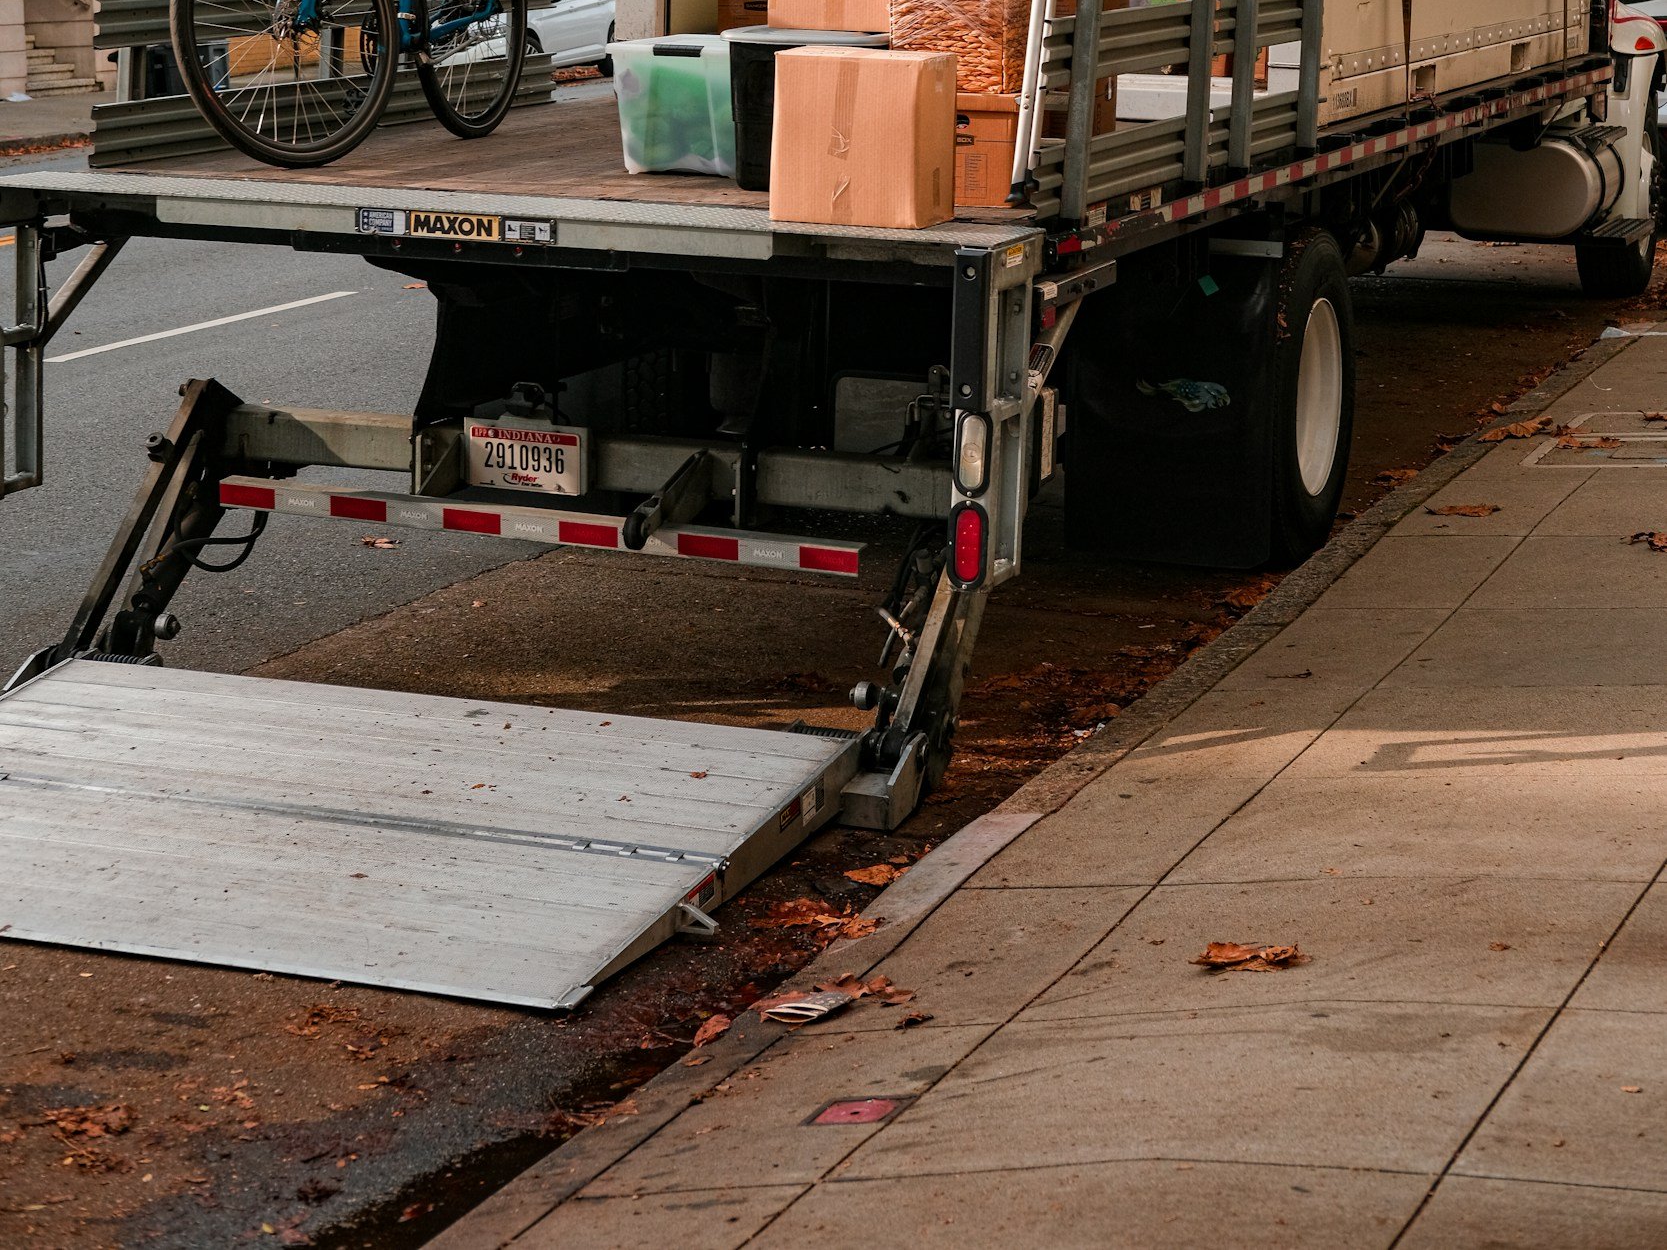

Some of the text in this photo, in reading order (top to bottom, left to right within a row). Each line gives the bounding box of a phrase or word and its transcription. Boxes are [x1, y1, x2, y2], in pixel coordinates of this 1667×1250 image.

[369, 211, 393, 219] AMERICAN
[369, 219, 393, 227] COMPANY
[412, 215, 493, 237] MAXON
[498, 429, 553, 444] INDIANA
[484, 441, 565, 474] 2910936
[511, 473, 538, 483] Ryder
[288, 498, 315, 507] MAXON
[400, 510, 428, 520] MAXON
[515, 523, 543, 533] MAXON
[754, 549, 783, 559] MAXON
